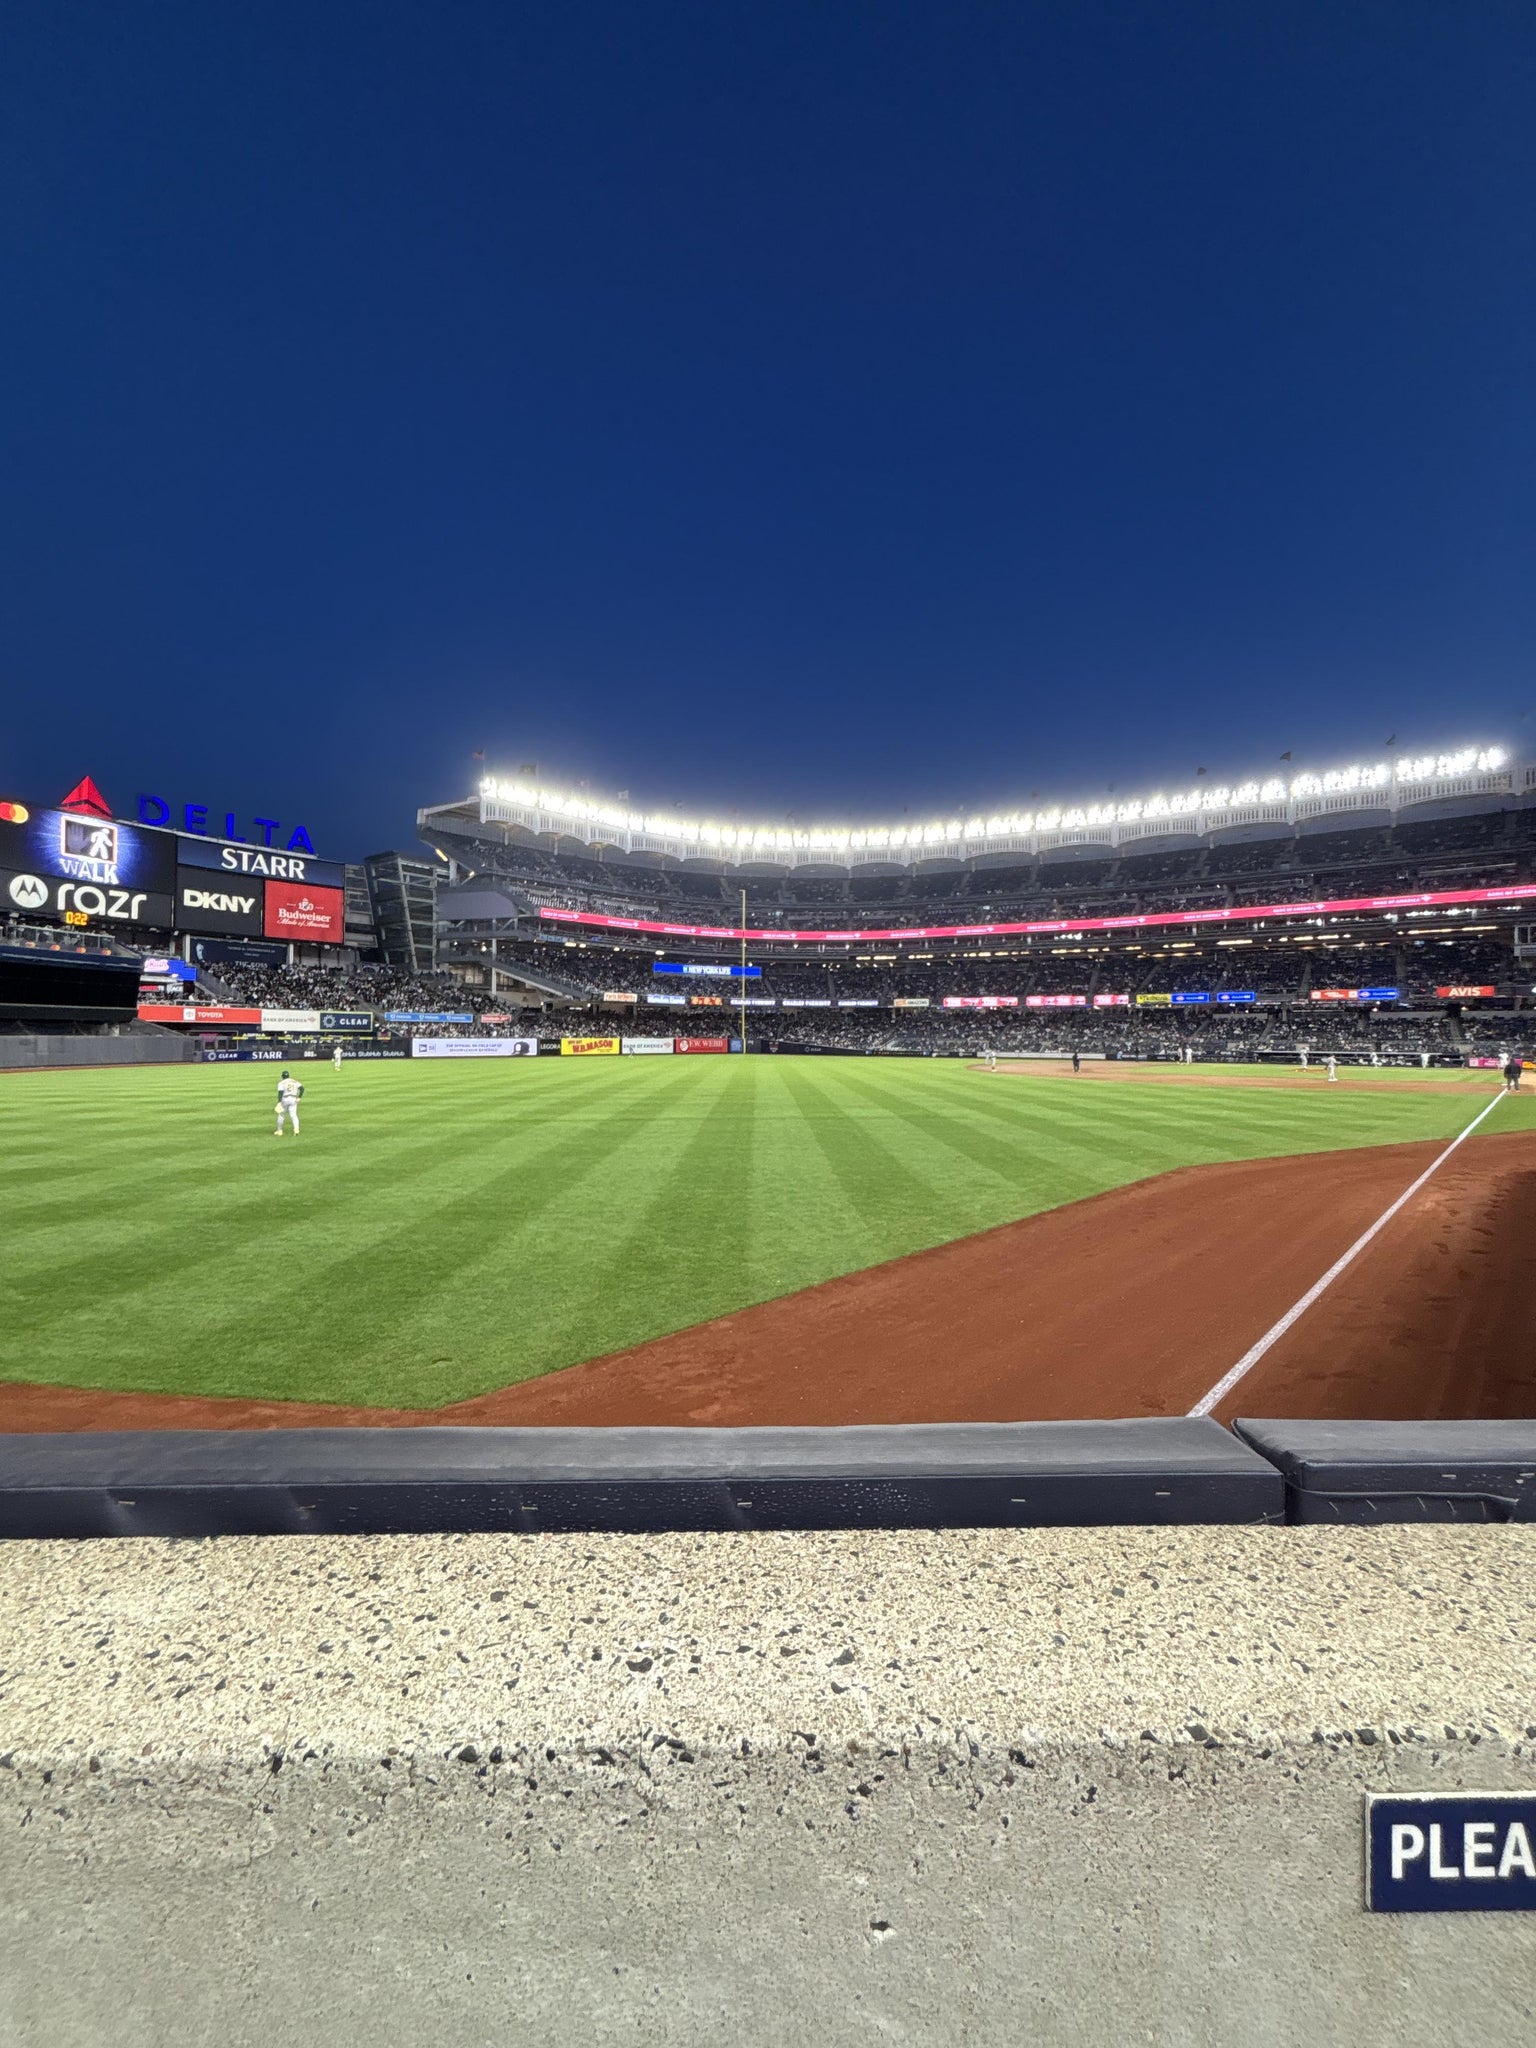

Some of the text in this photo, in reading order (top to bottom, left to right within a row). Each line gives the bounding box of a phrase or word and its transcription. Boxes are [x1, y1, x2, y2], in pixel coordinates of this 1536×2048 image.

[138, 794, 315, 854] DELTA
[59, 859, 119, 884] WALK
[221, 848, 305, 880] STARR
[57, 883, 147, 920] razr
[183, 889, 255, 913] DKNY
[66, 911, 88, 926] 0:22
[278, 908, 331, 922] Budweiser
[1448, 986, 1481, 997] AVIS
[252, 1051, 282, 1059] STARR
[1391, 1822, 1536, 1879] PLEA
